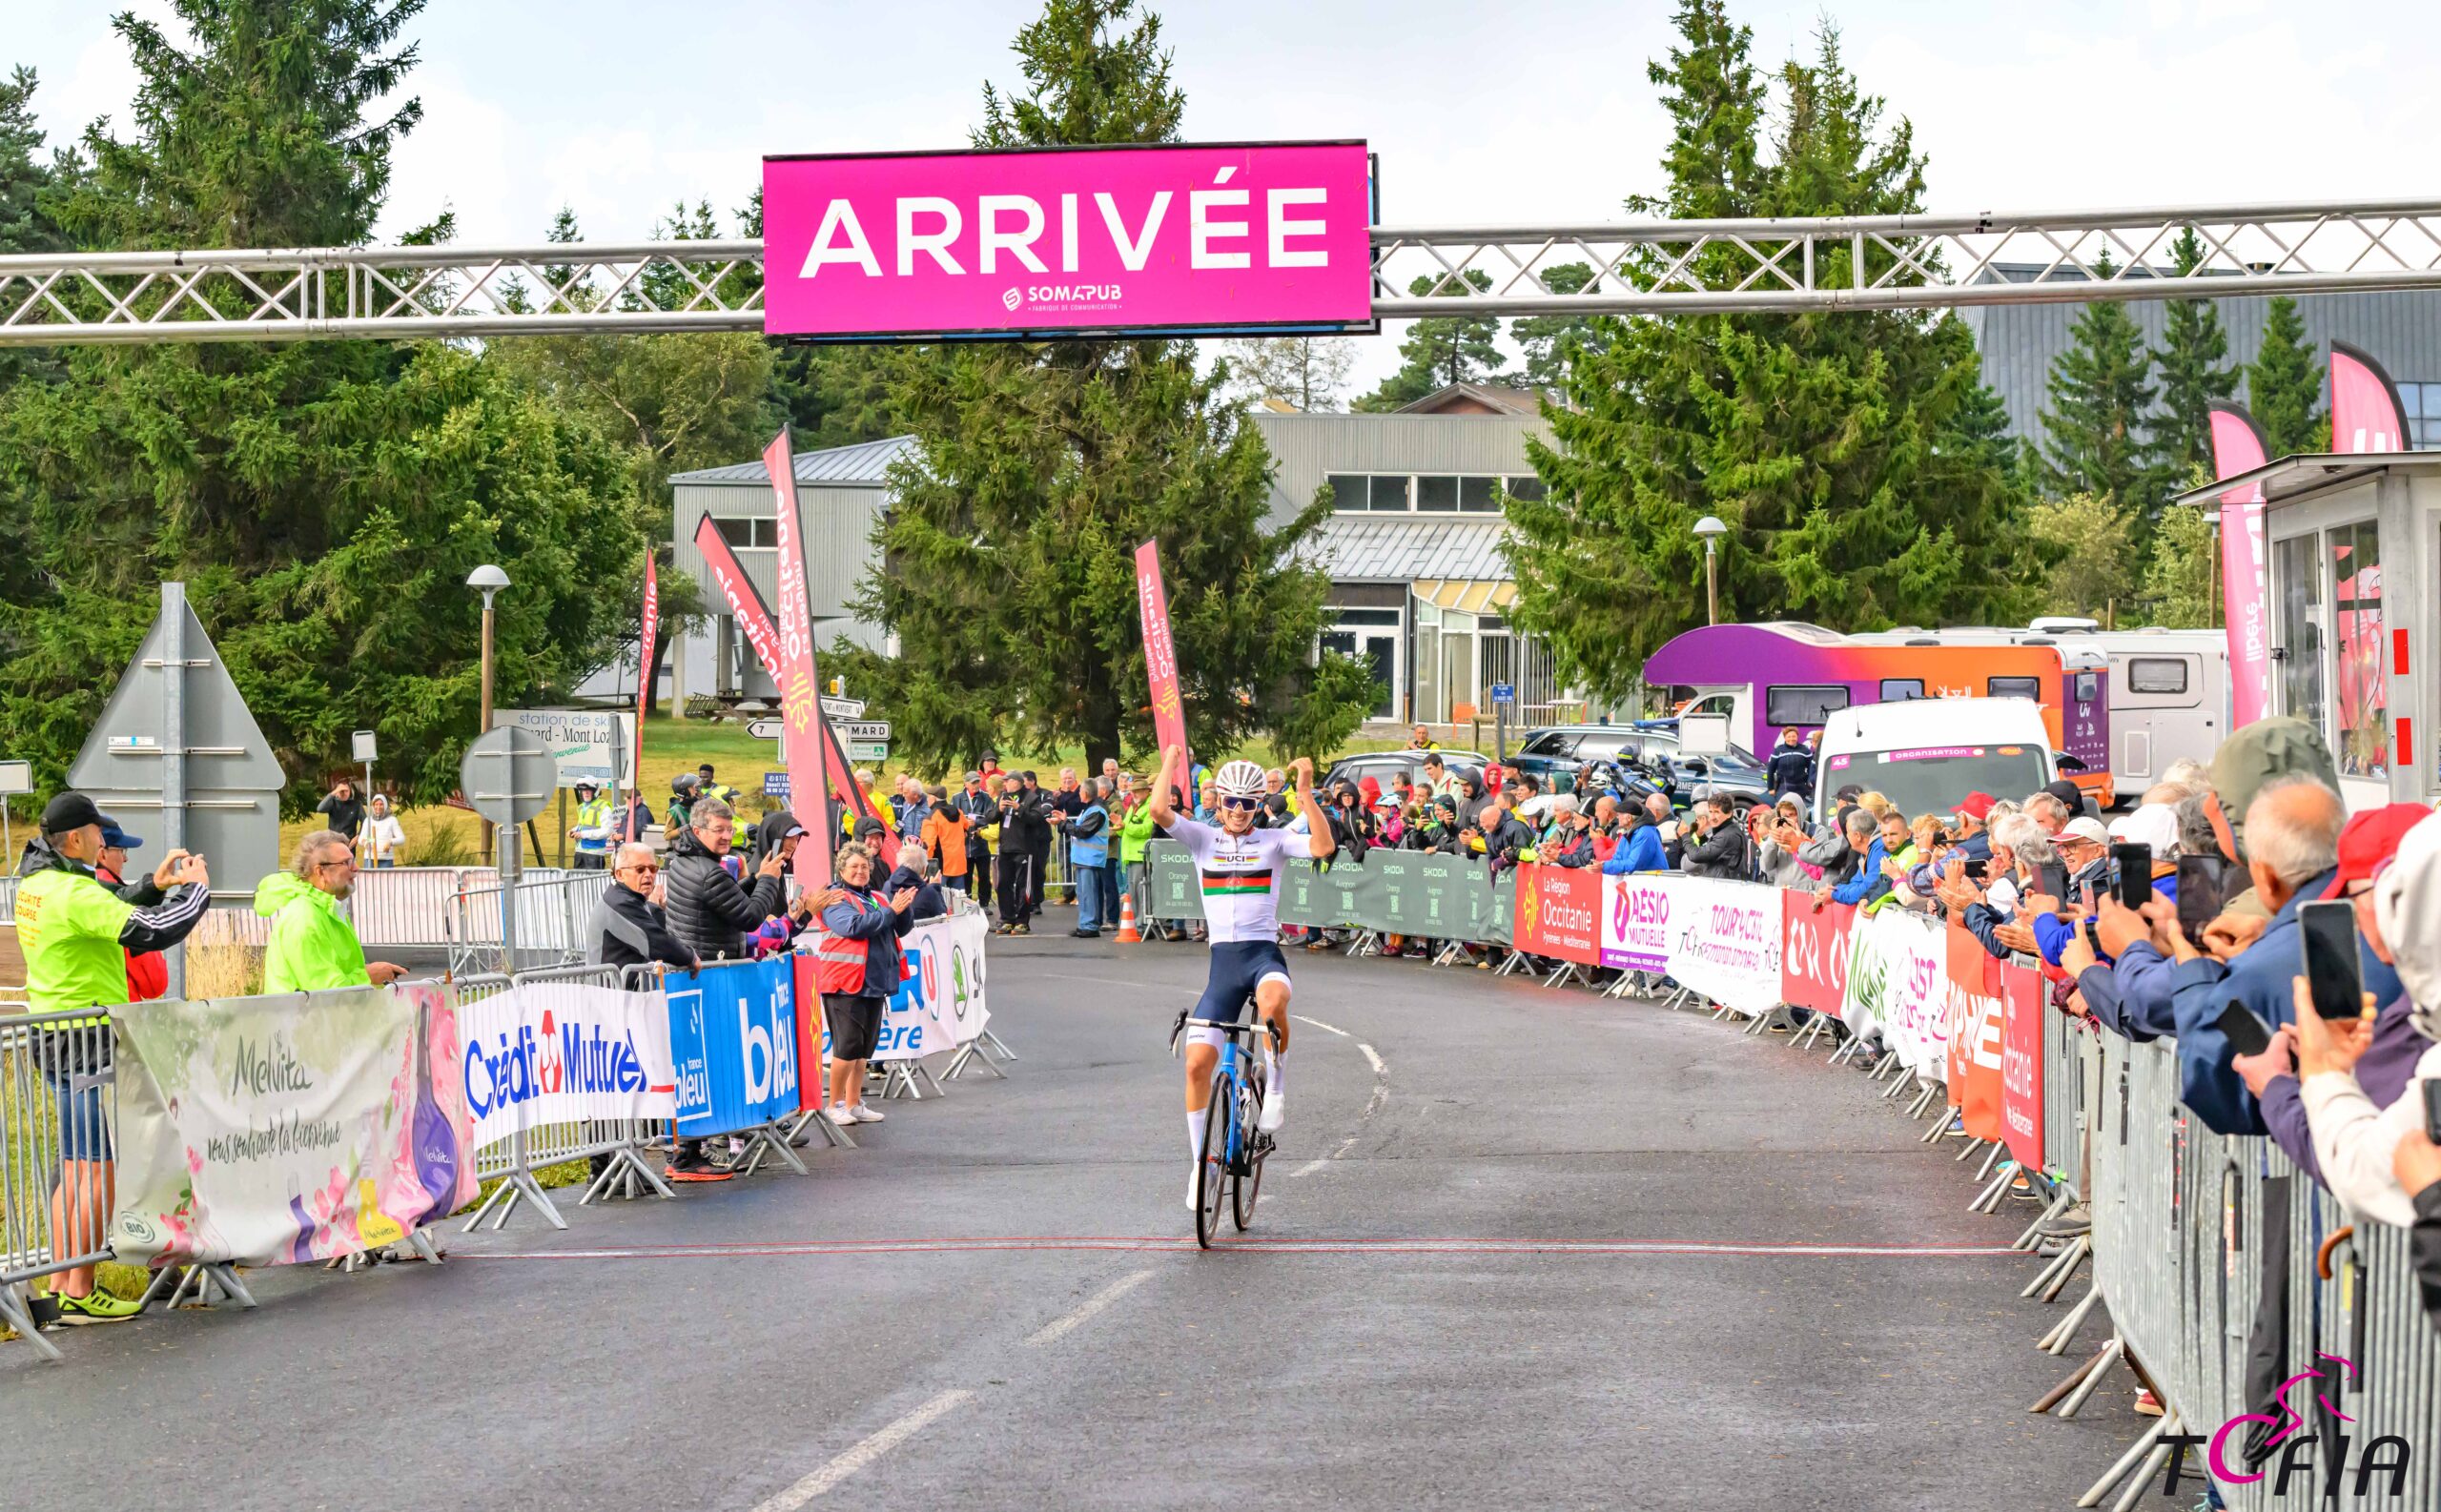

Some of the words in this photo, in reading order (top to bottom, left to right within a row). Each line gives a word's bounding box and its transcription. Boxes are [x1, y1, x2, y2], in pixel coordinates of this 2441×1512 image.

[798, 166, 1329, 279] ARRIVÉE
[1028, 284, 1122, 302] SOMAPUB
[519, 712, 566, 725] station
[572, 713, 590, 725] de
[563, 727, 591, 743] Mont
[759, 725, 765, 734] 7
[851, 726, 886, 735] MARD
[1833, 758, 1848, 766] 45
[1895, 748, 1967, 759] ORGANISATION
[1168, 871, 1190, 883] Orange
[1543, 877, 1550, 892] La
[1550, 878, 1570, 898] Région
[1543, 898, 1591, 932] Occitanie
[1630, 888, 1670, 926] AÉSIO
[1629, 928, 1665, 949] MUTUELLE
[775, 978, 790, 1009] france
[738, 993, 795, 1105] bleu
[233, 1030, 313, 1098] Melvita
[464, 1025, 540, 1120] Crédit
[562, 1023, 647, 1094] Mutuel
[687, 1056, 703, 1071] france
[672, 1063, 707, 1110] bleu
[207, 1134, 231, 1165] vous
[231, 1114, 277, 1163] souhaite
[278, 1108, 292, 1156] la
[292, 1108, 342, 1155] bienvenue
[125, 1221, 146, 1235] BIO
